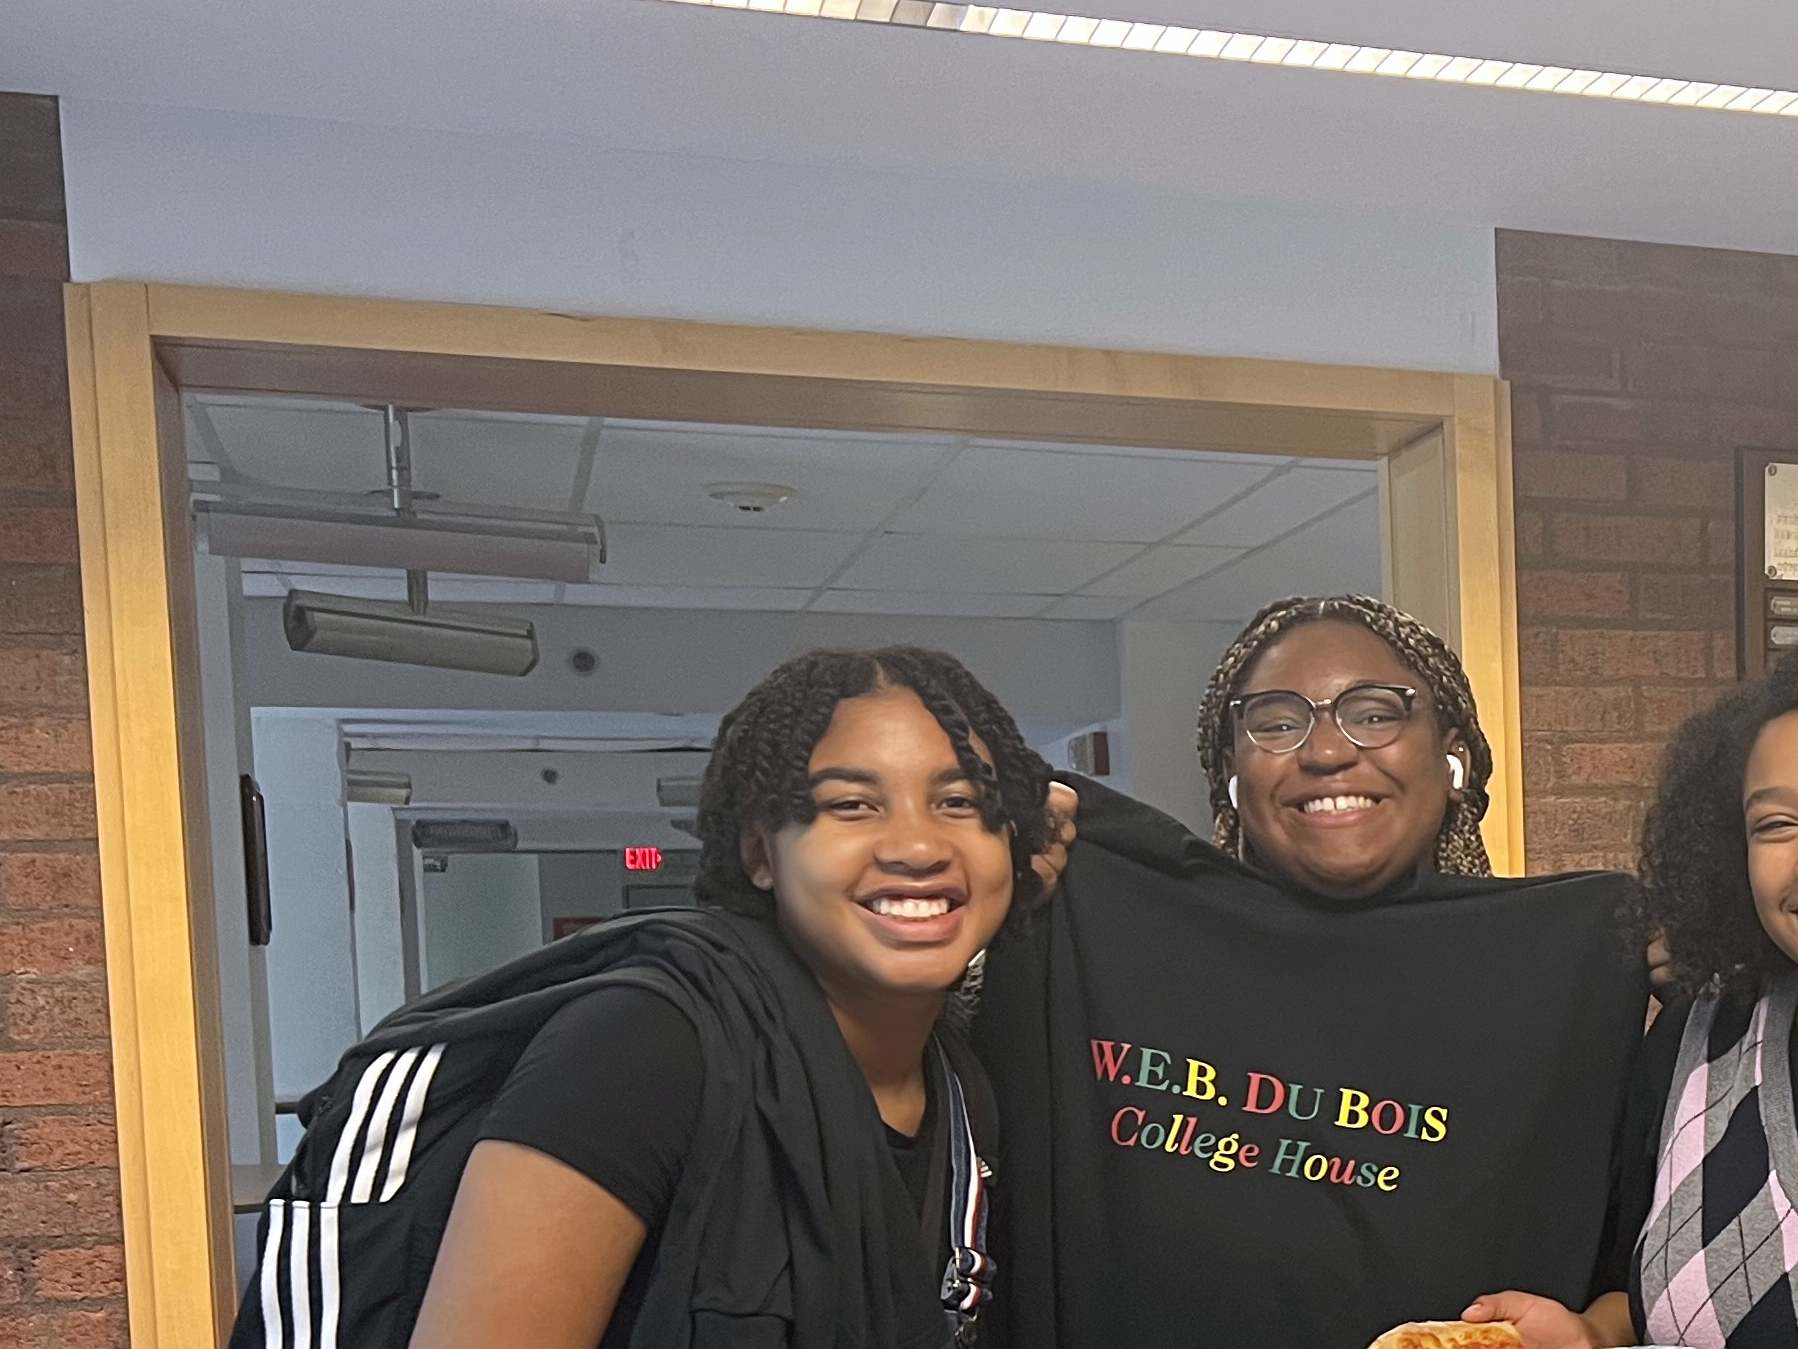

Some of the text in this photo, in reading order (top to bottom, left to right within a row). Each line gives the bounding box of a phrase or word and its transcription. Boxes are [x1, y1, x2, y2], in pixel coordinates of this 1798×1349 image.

[625, 847, 658, 869] EXIT
[1089, 1038, 1449, 1143] W.E.B. DU BOIS
[1110, 1106, 1400, 1192] College House
